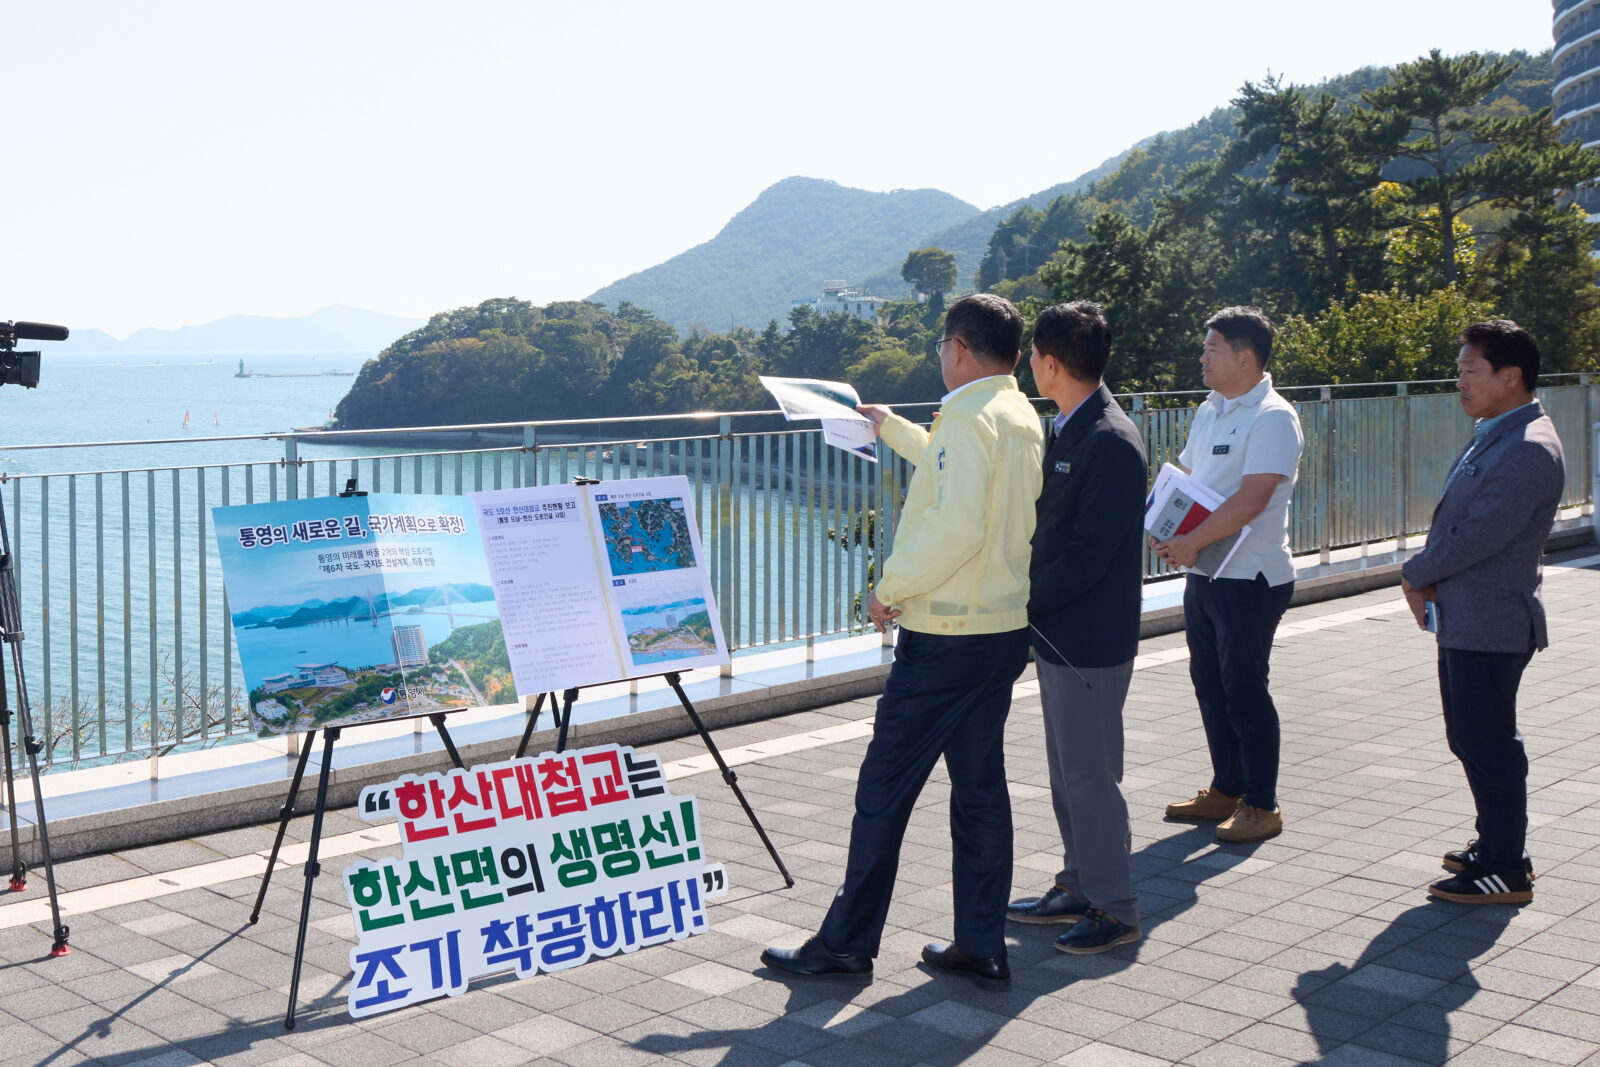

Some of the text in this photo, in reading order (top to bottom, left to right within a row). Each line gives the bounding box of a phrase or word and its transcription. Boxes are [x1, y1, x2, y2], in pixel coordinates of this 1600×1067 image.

[483, 508, 495, 517] 국도
[512, 504, 541, 515] 한산대첩교
[564, 501, 576, 510] 보고
[239, 515, 466, 547] 통영의 새로운 길, 국가계획으로 확정!
[317, 546, 433, 563] 통영의 미래를 바꿀 2개의 핵심 도로사업
[412, 557, 424, 567] 최종
[424, 557, 436, 567] 반영
[348, 800, 702, 932] 한산면의 생명선!
[355, 929, 462, 1010] 조기
